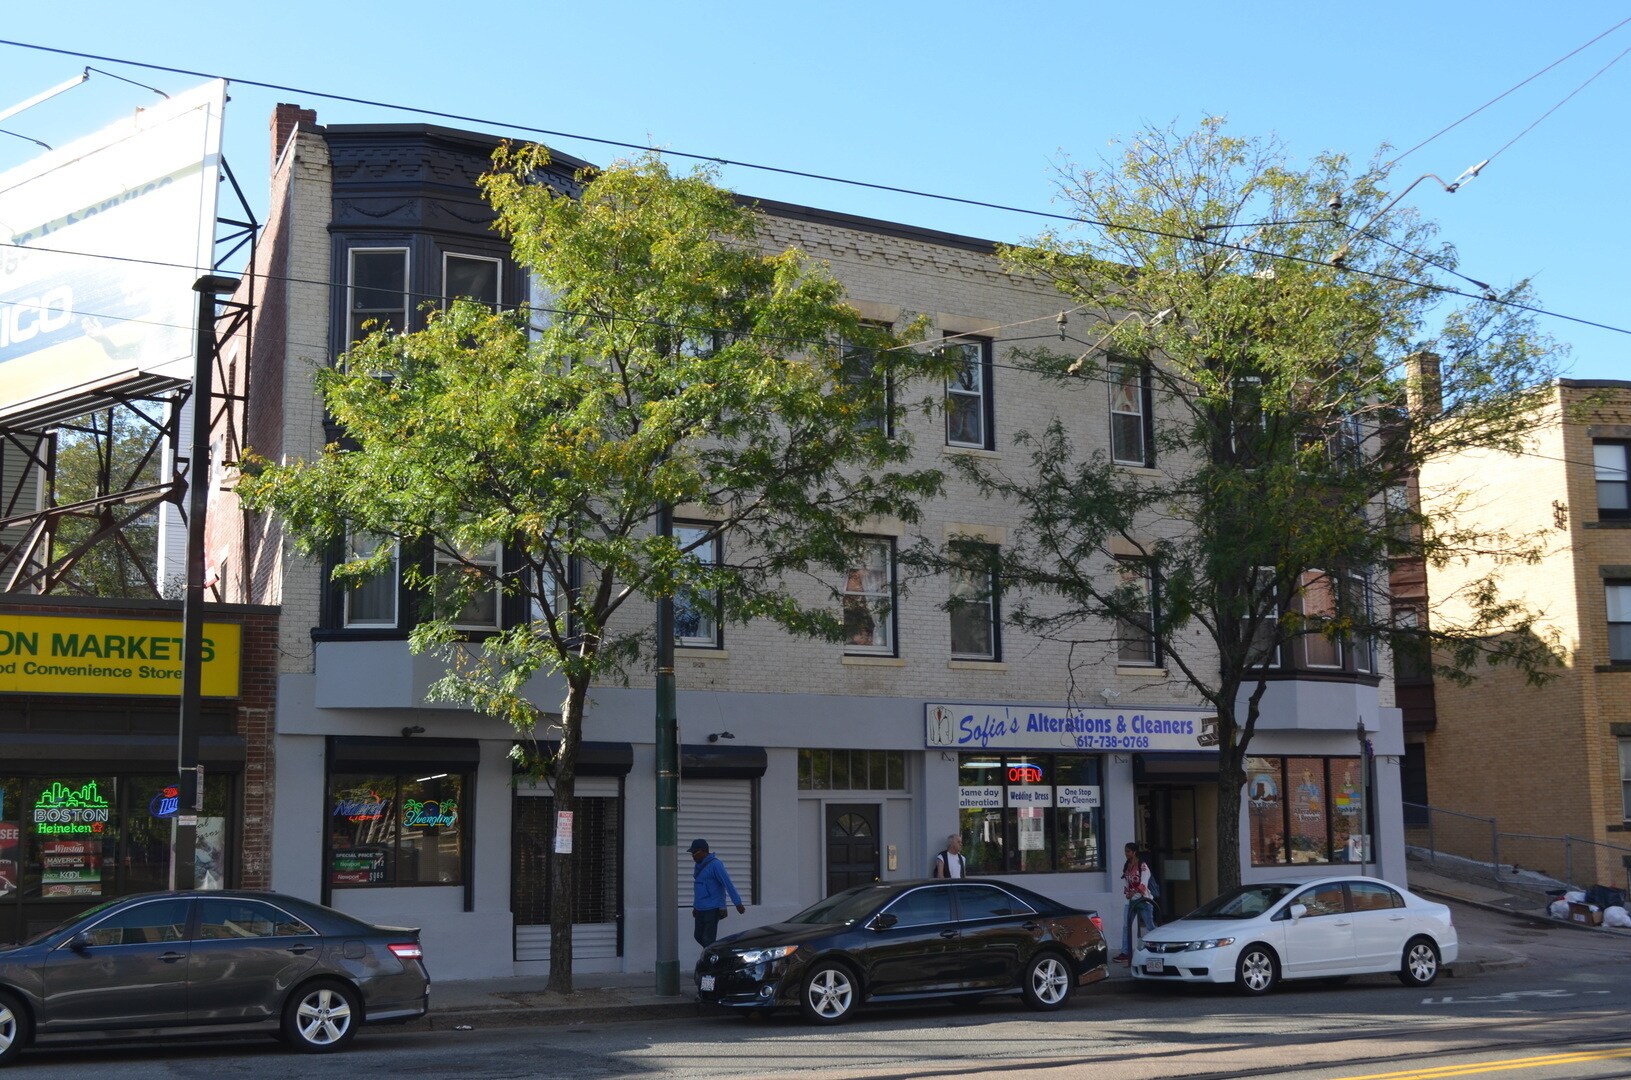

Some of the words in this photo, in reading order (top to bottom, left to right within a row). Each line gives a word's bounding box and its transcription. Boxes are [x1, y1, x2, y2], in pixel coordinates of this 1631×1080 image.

[52, 633, 216, 662] MARKETS
[23, 661, 132, 678] Convenience
[138, 665, 183, 680] Store
[958, 707, 1021, 748] Sofia's
[1026, 712, 1112, 733] Alterations
[1116, 714, 1127, 734] &
[1131, 714, 1194, 735] Cleaners
[1077, 735, 1149, 749] 617-738-0768
[1008, 768, 1041, 783] OPEN
[960, 788, 982, 797] Same
[983, 787, 999, 798] day
[1010, 791, 1032, 802] Wedding
[1034, 791, 1049, 801] Dress
[1064, 788, 1078, 796] One
[1078, 788, 1092, 797] Stop
[959, 798, 999, 807] alteration
[1059, 796, 1071, 805] Dry
[1071, 796, 1097, 804] Cleaners
[34, 808, 109, 823] BOSTON
[404, 811, 457, 827] Yuengling
[38, 823, 93, 834] Heineken
[55, 844, 84, 853] Winston
[47, 856, 83, 864] MAVERICK
[60, 870, 82, 880] KOOL
